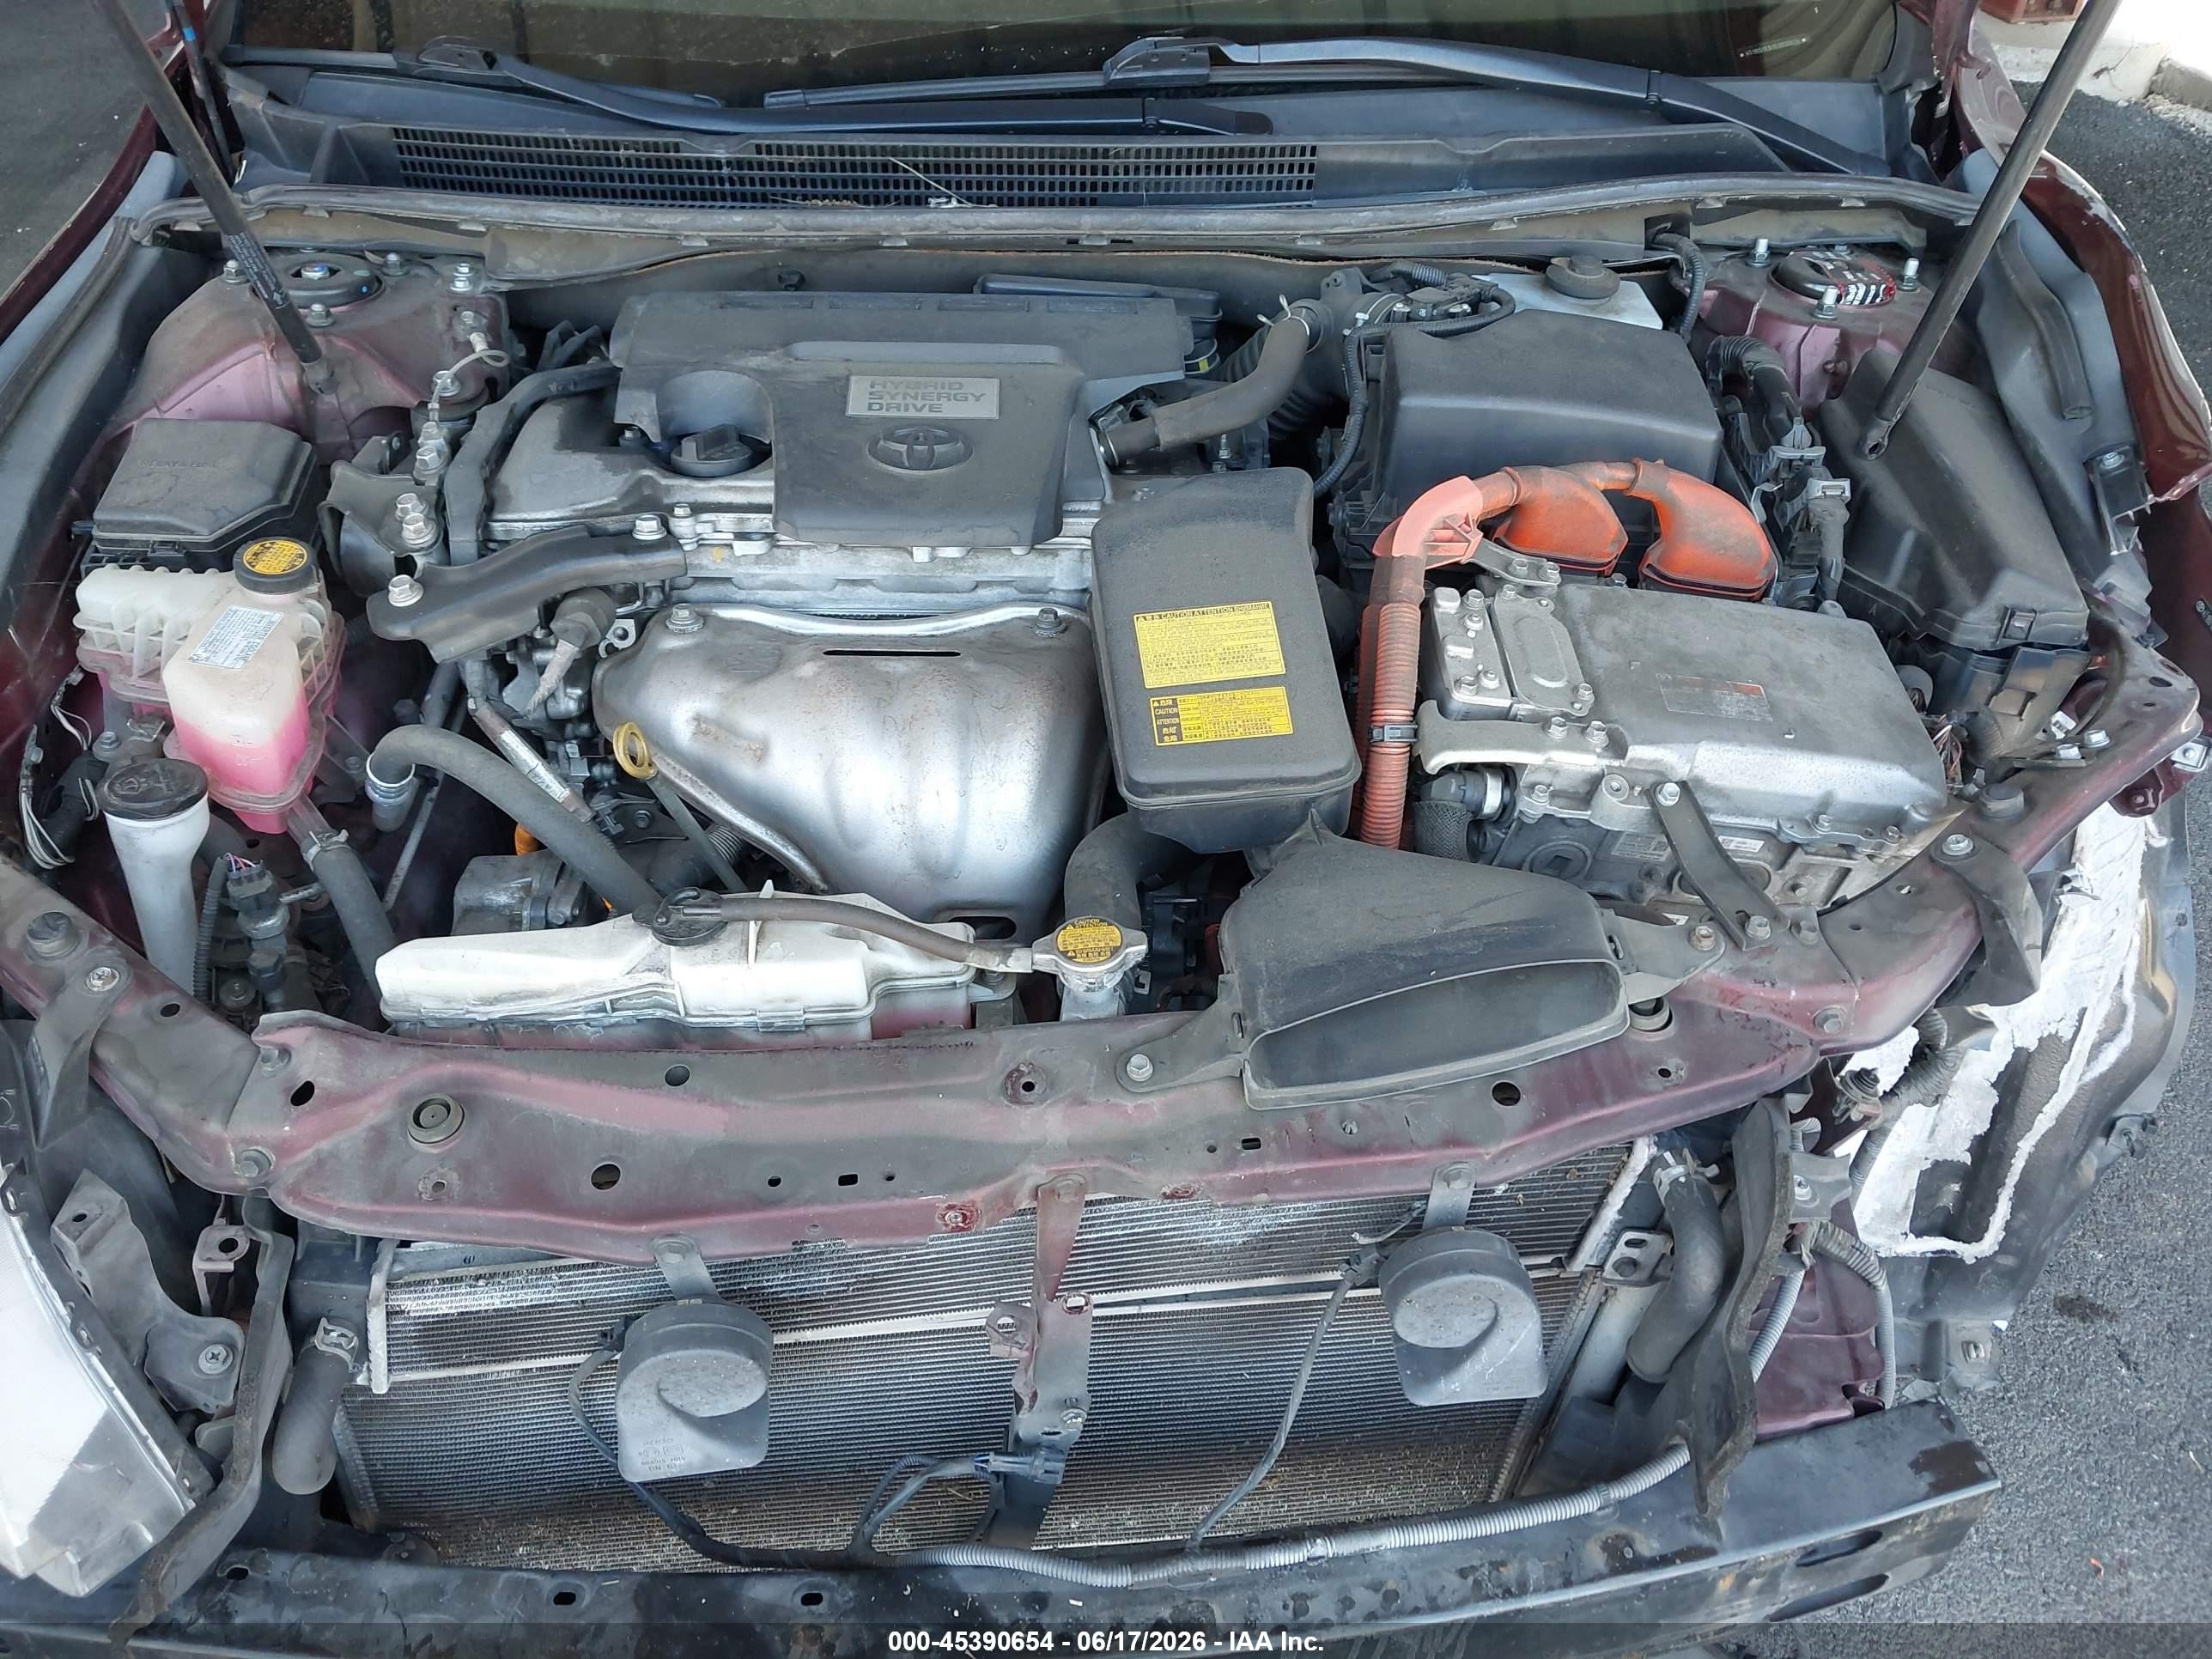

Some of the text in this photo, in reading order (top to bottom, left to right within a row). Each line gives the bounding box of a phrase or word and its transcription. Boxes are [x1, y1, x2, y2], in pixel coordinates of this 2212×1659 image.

[869, 380, 964, 391] HYBRID
[867, 390, 986, 402] SYNERGY
[867, 402, 944, 413] DRIVE
[1161, 611, 1194, 619] CAUTION
[1194, 606, 1235, 617] ATTENTION
